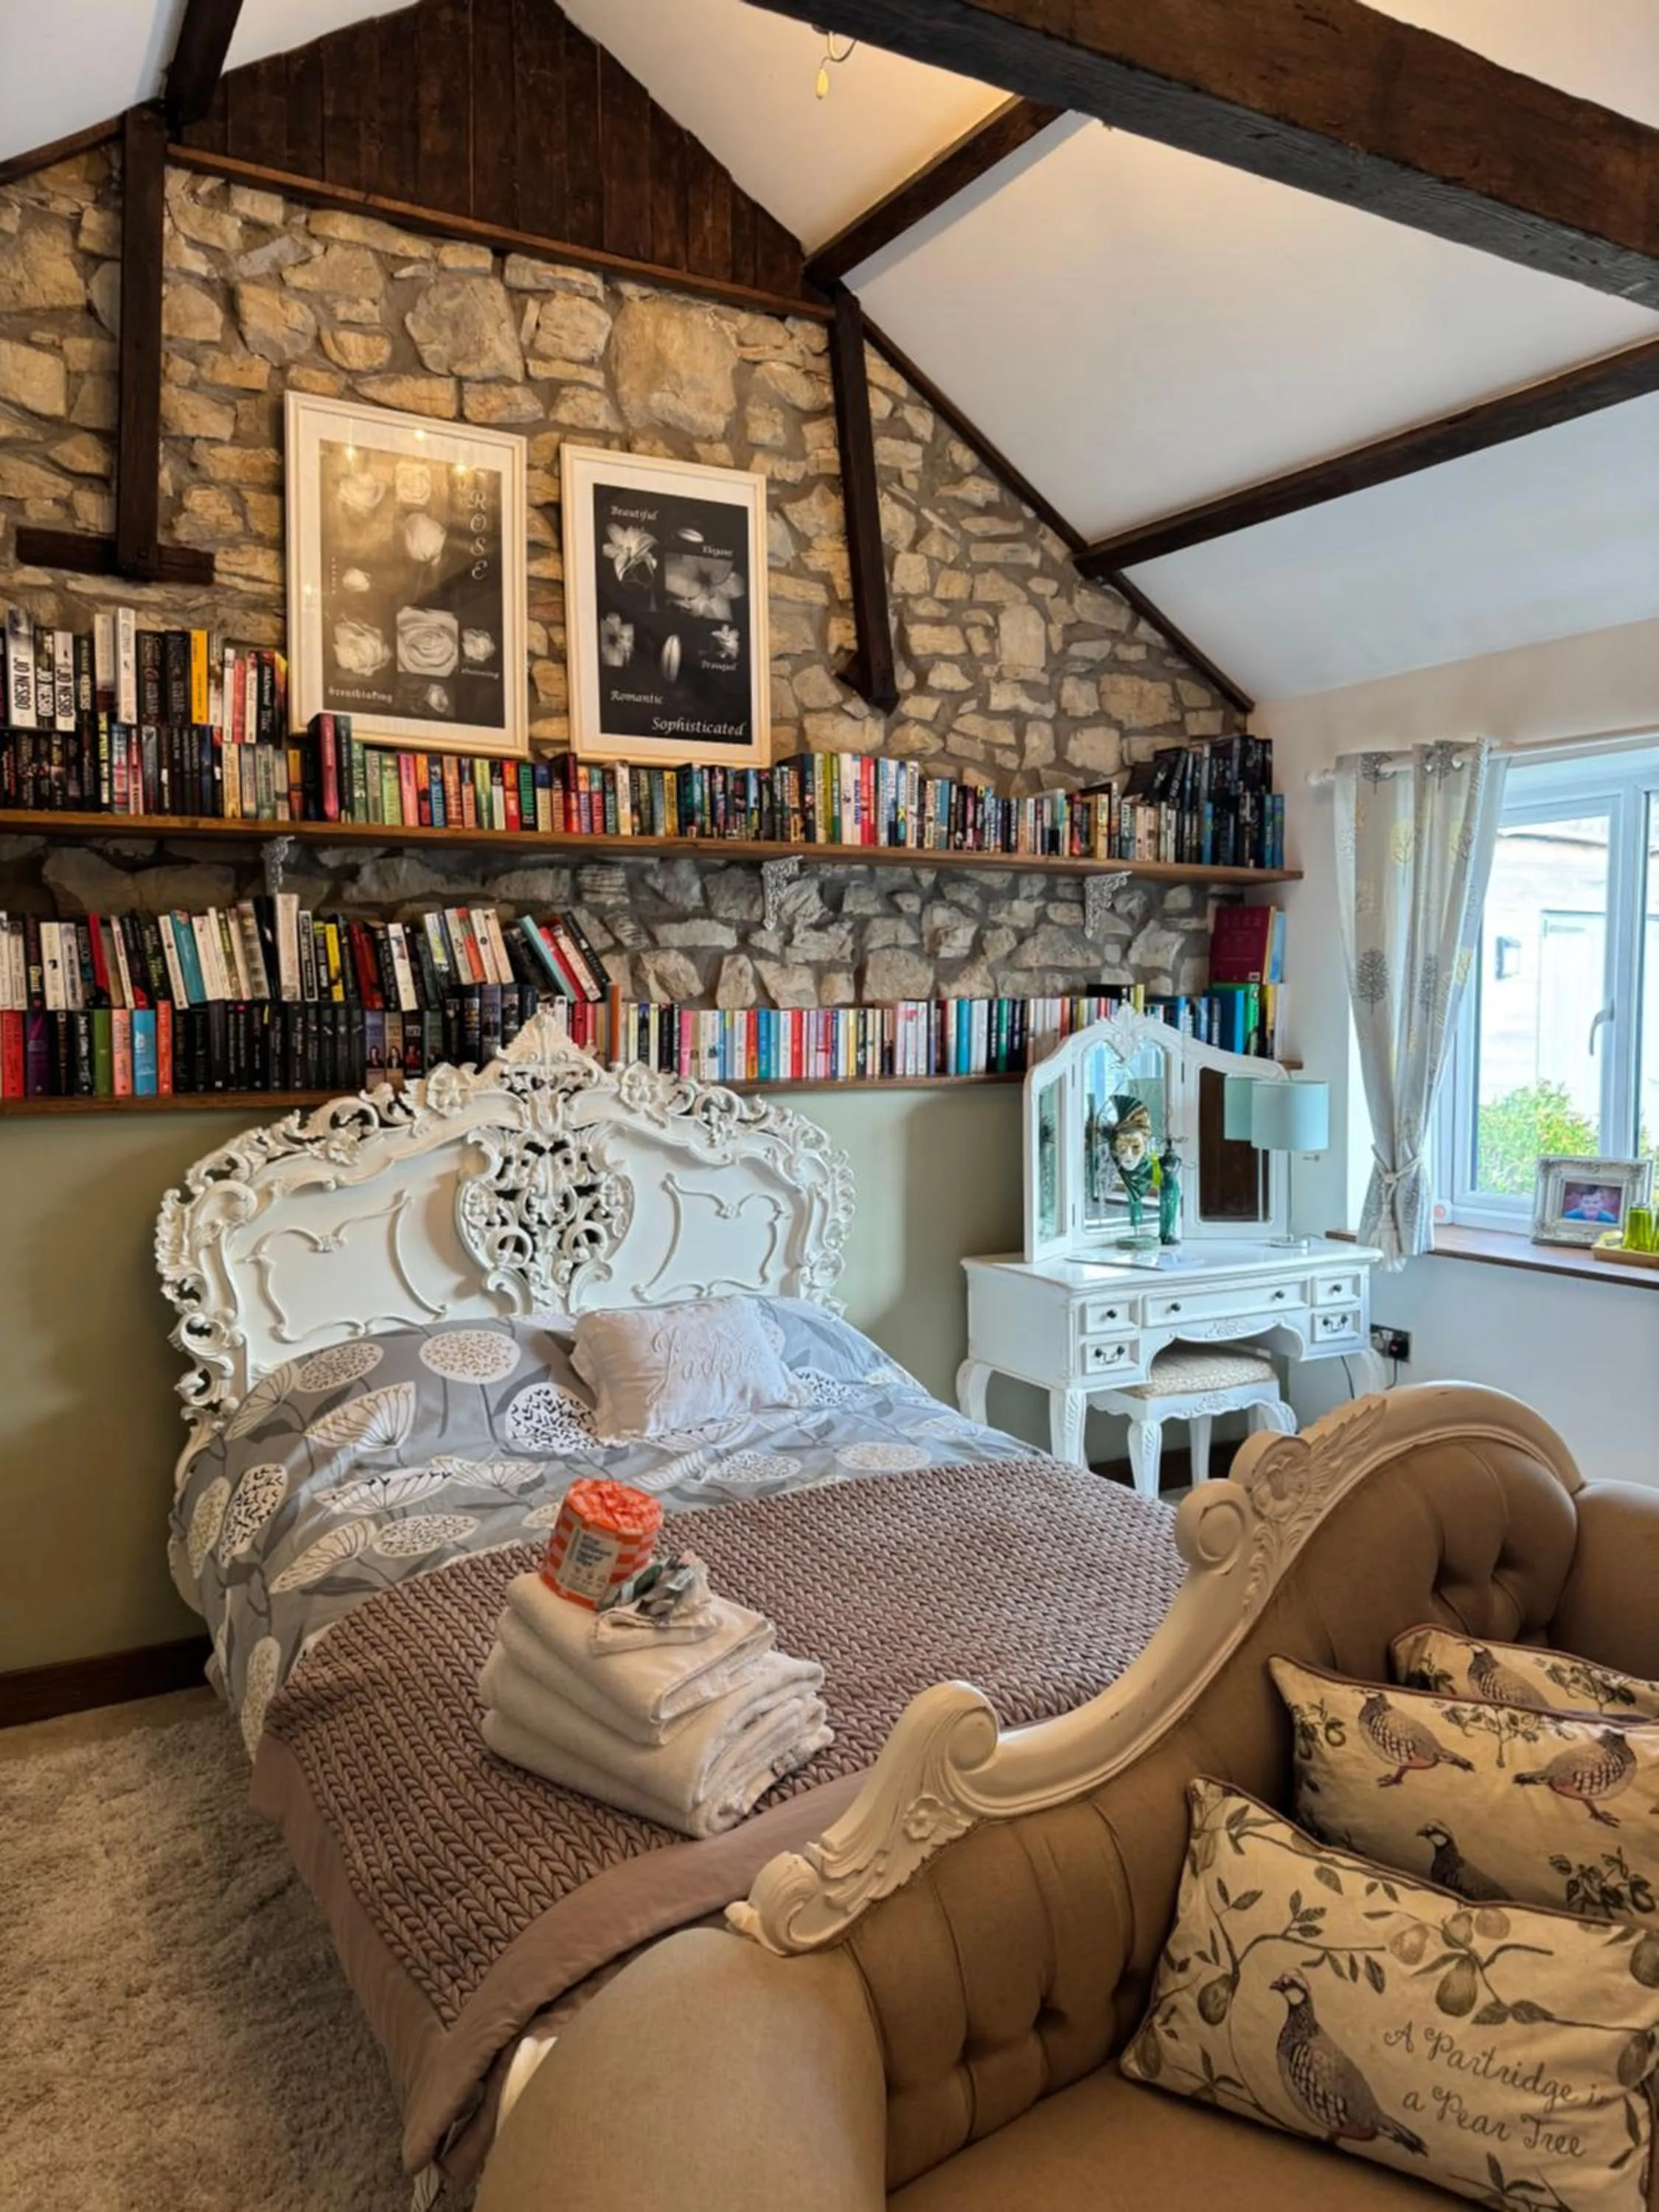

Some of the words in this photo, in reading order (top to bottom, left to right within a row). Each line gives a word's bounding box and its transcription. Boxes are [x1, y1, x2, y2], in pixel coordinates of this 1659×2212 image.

[467, 490, 488, 580] ROSE
[610, 504, 660, 521] Beautiful
[610, 689, 664, 705] Romantic
[652, 717, 745, 737] Sophisticated
[1384, 2021, 1413, 2053] A
[1425, 2026, 1579, 2112] Partridge
[1403, 2090, 1427, 2112] a
[1432, 2085, 1513, 2142] Pear
[1520, 2113, 1587, 2158] Tree
